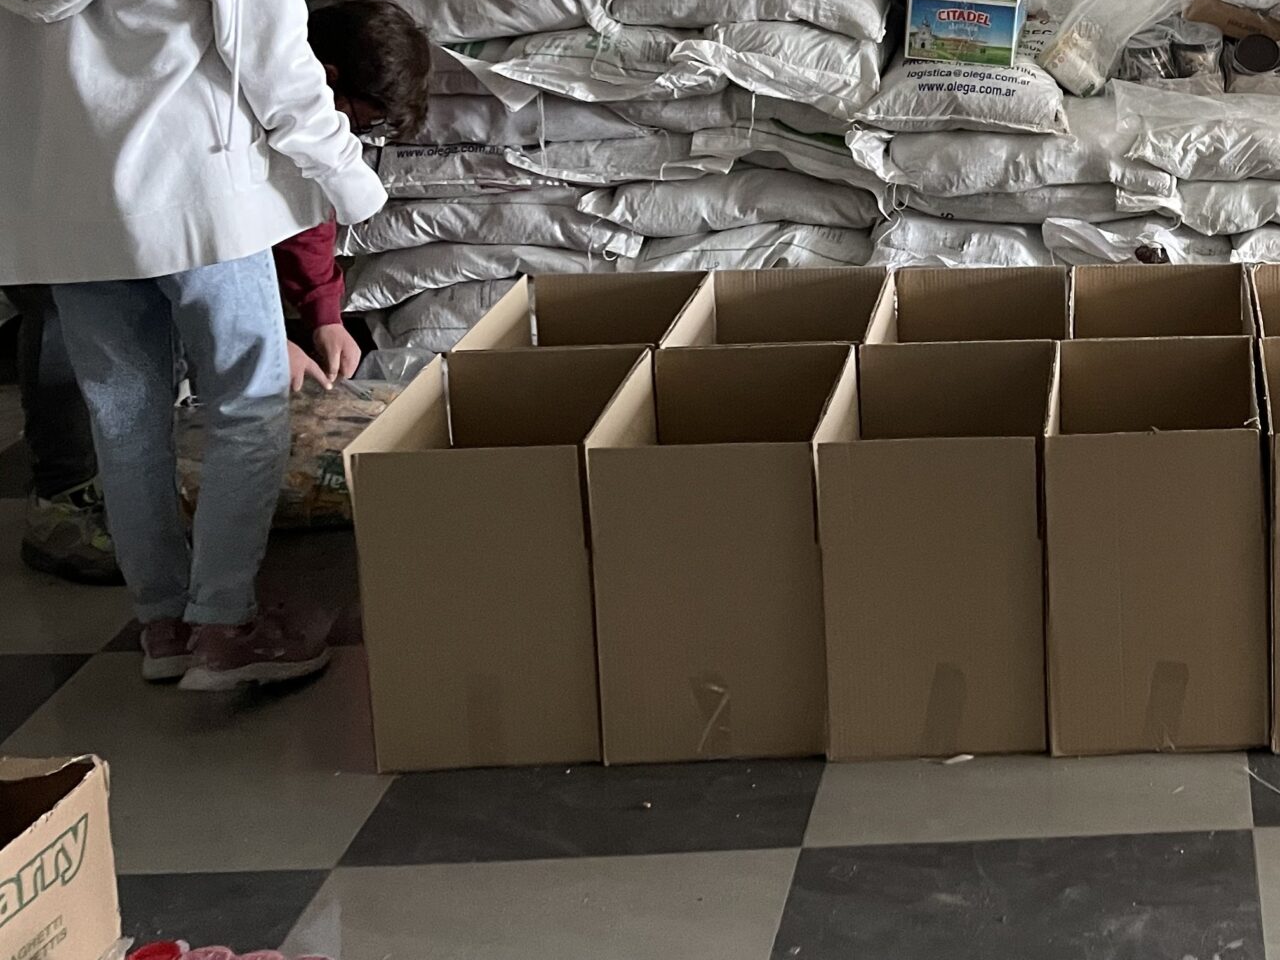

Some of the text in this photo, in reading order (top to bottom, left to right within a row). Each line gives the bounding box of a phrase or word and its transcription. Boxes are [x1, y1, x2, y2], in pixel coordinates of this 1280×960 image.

[937, 9, 991, 27] CITADEL
[906, 69, 1031, 87] logistica@olega.com.ar
[918, 81, 1017, 98] www.olega.com.ar
[0, 813, 89, 928] arry
[10, 914, 64, 960] AGHETTI
